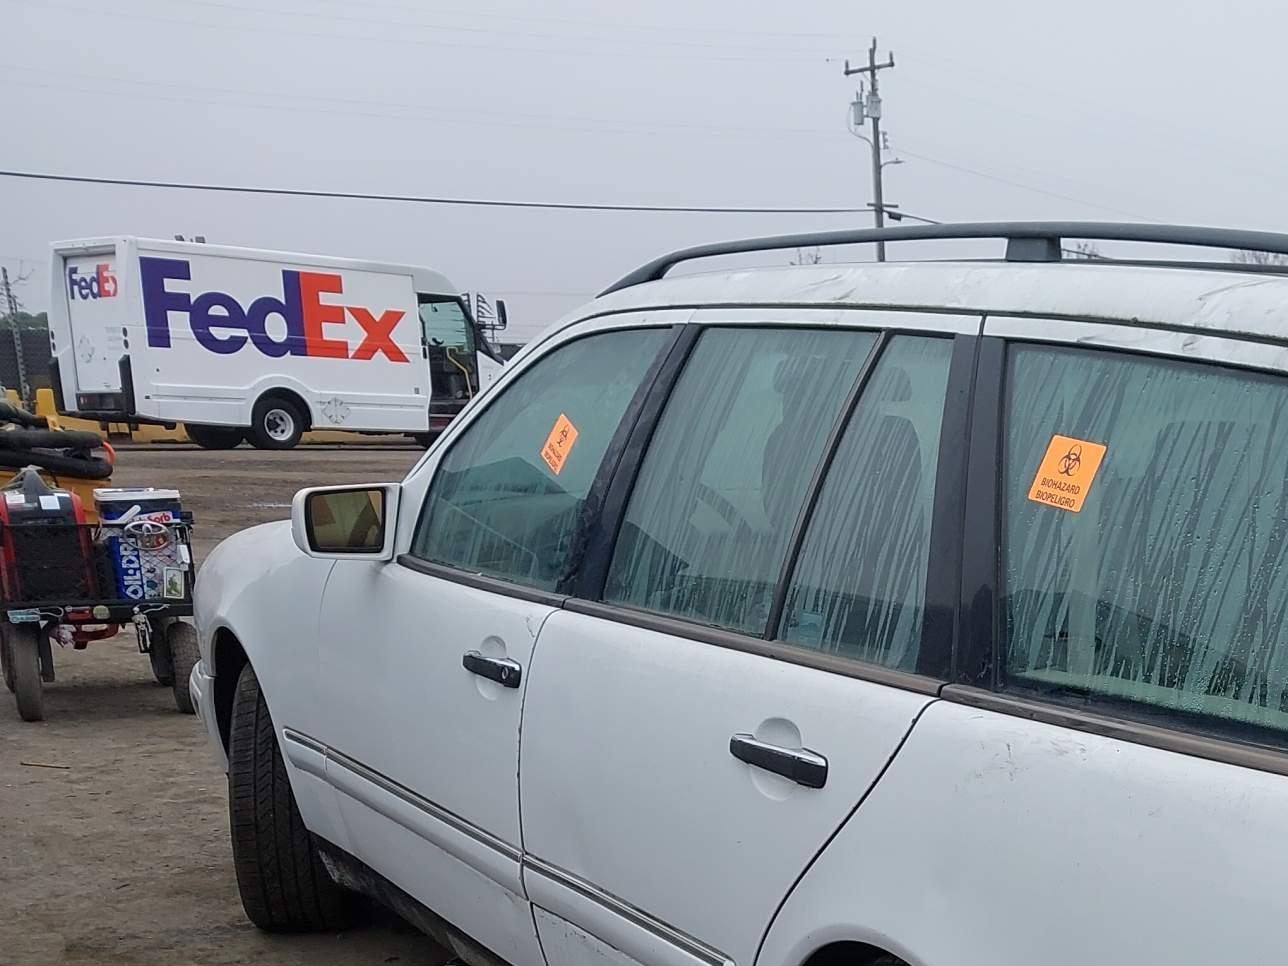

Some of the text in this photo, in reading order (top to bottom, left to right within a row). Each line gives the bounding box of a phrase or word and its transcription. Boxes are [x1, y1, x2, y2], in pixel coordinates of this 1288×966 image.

[139, 256, 410, 363] FedEx
[1041, 478, 1080, 494] BIOHAZARD
[1035, 490, 1075, 508] BIOPELIGRO
